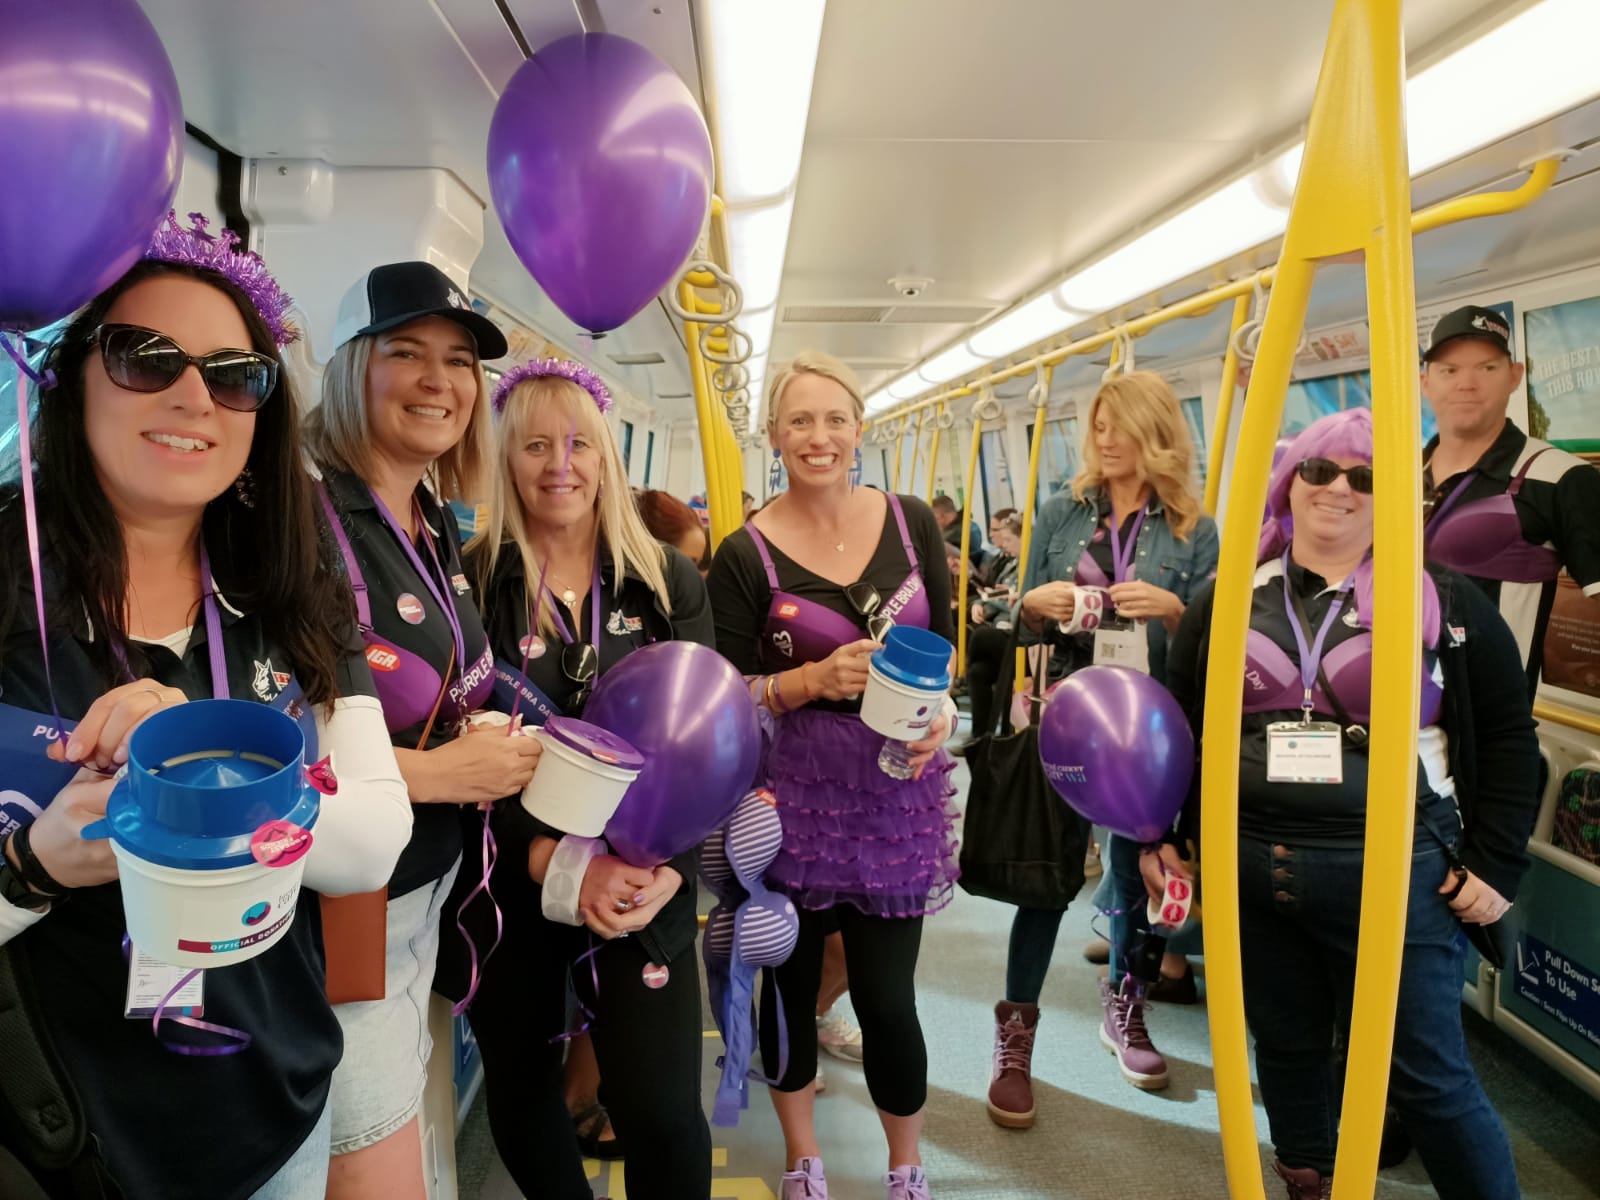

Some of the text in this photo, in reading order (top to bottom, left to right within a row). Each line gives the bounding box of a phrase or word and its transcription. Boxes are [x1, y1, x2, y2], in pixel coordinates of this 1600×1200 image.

[879, 600, 903, 618] PLE
[367, 648, 398, 668] IGA
[496, 670, 521, 689] URPLE
[520, 687, 538, 706] BRA
[210, 937, 255, 951] OFFICIAL
[1545, 950, 1561, 970] Pull
[1563, 961, 1589, 987] Down
[1545, 969, 1577, 1001] To Use
[1569, 1017, 1578, 1030] Up
